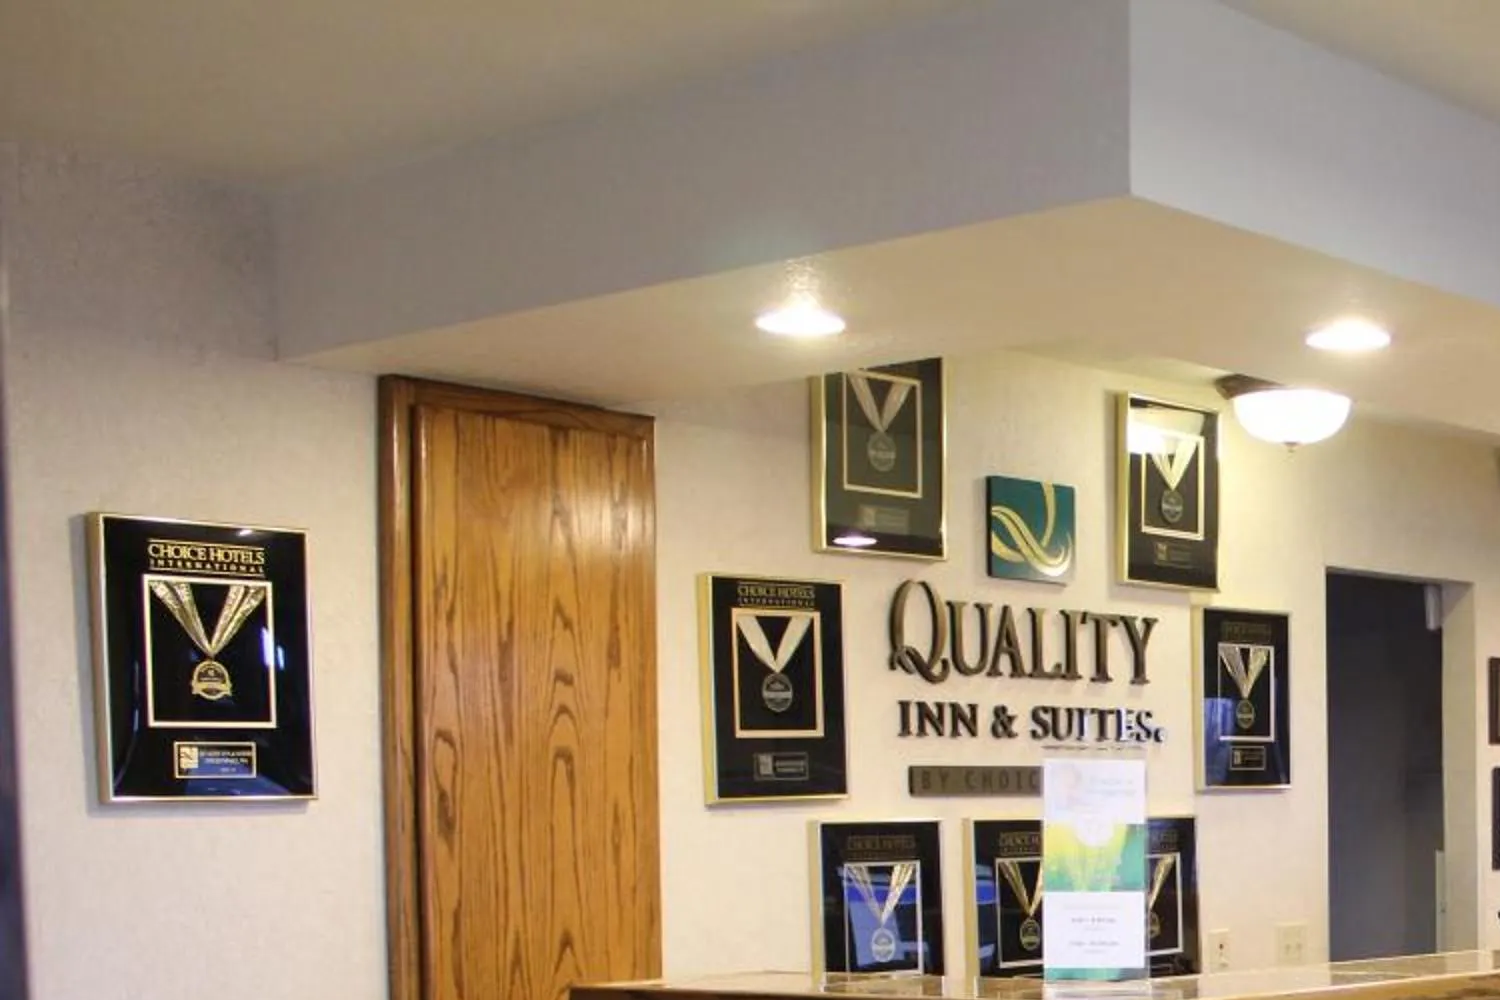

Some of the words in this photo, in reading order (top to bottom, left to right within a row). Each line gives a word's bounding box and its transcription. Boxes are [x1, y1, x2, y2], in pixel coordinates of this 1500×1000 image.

[148, 543, 207, 560] CHOICE
[209, 547, 265, 565] HOTELS
[888, 578, 1159, 685] QUALITY
[897, 699, 979, 738] INN
[990, 704, 1019, 739] &
[1030, 705, 1154, 743] SUITES
[921, 769, 950, 791] BY
[963, 768, 1041, 791] CHOIC
